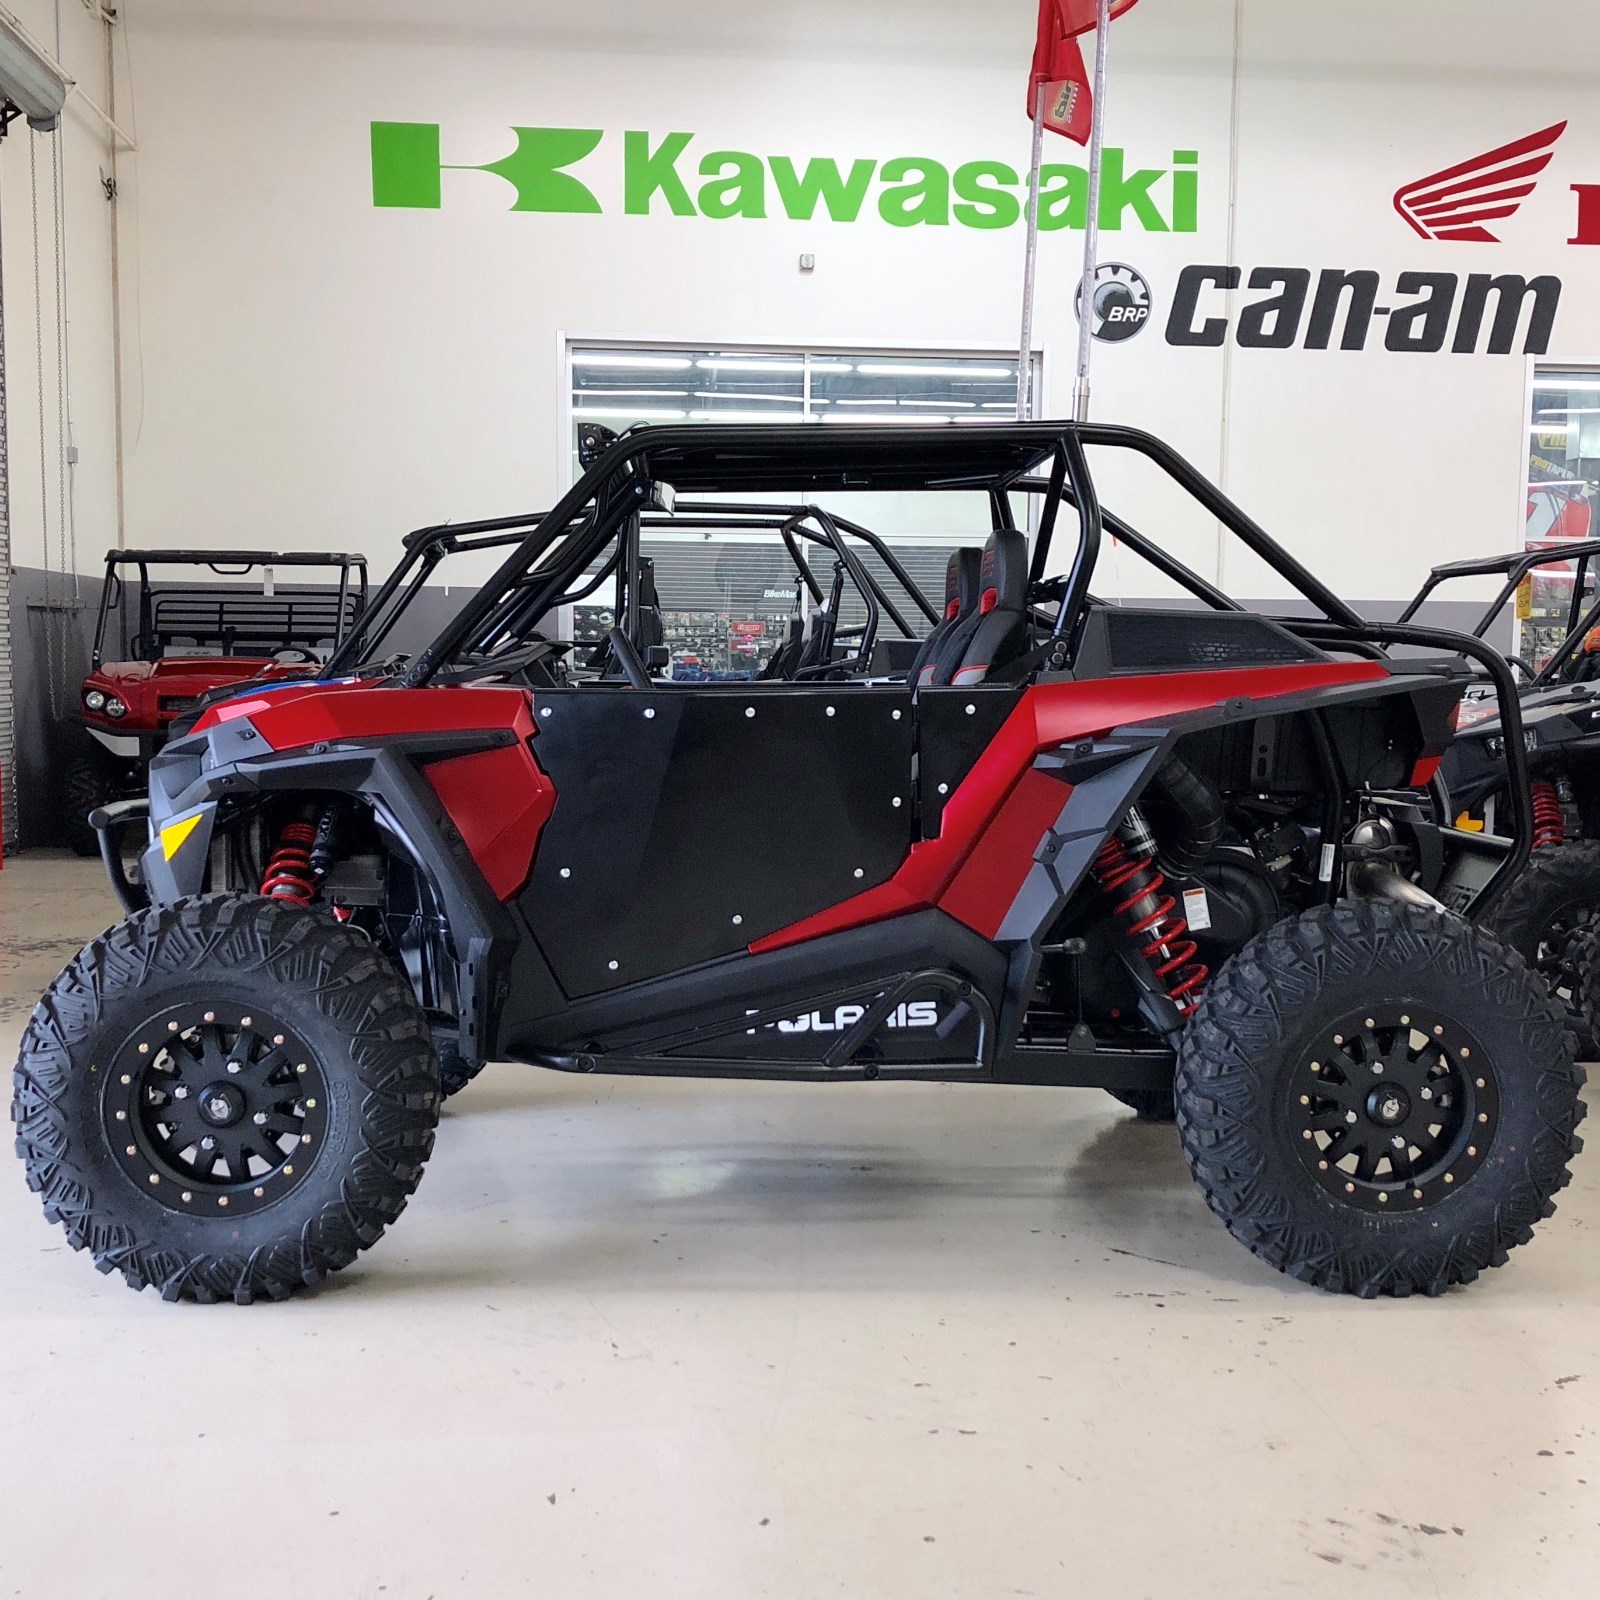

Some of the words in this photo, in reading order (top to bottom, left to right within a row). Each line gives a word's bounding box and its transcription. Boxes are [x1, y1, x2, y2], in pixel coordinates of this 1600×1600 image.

[624, 131, 1198, 232] Kawasaki
[1108, 306, 1148, 323] BRP
[763, 589, 797, 599] BikeMas
[745, 1001, 938, 1035] OLAIS
